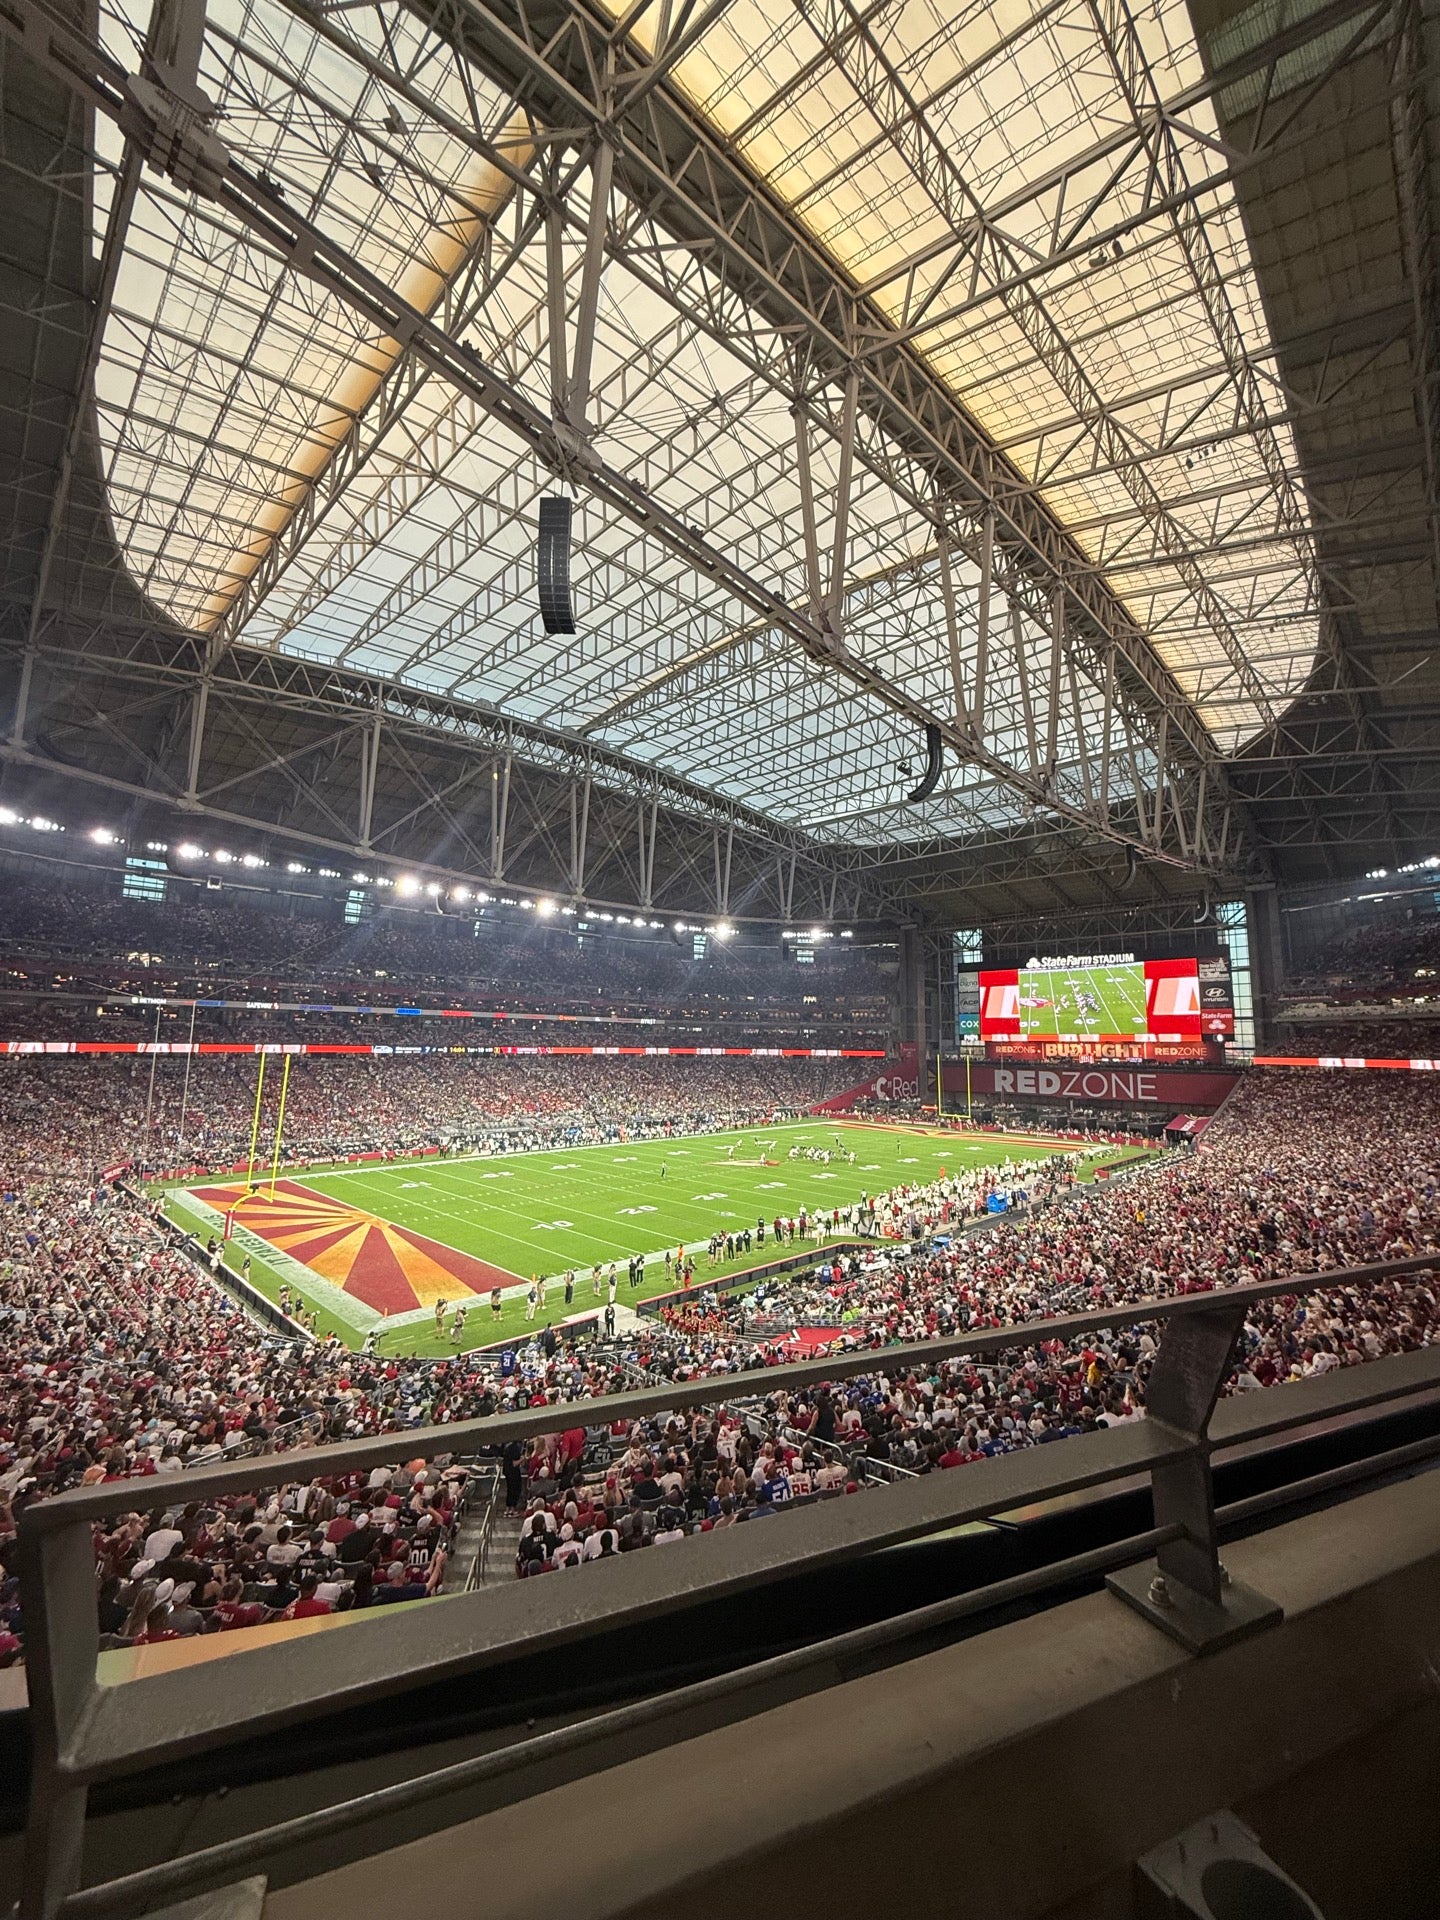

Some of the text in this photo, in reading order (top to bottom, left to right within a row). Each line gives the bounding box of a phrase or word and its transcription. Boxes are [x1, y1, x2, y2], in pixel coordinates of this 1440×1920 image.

[1093, 952, 1135, 964] STADIUM
[960, 1020, 980, 1028] COX
[1045, 1043, 1142, 1058] BUD LIGHT
[1154, 1046, 1208, 1056] REDZONE
[893, 1076, 919, 1098] Red
[994, 1069, 1158, 1100] REDZONE
[615, 1204, 659, 1215] 20
[530, 1220, 575, 1231] 10
[411, 1548, 429, 1565] 00
